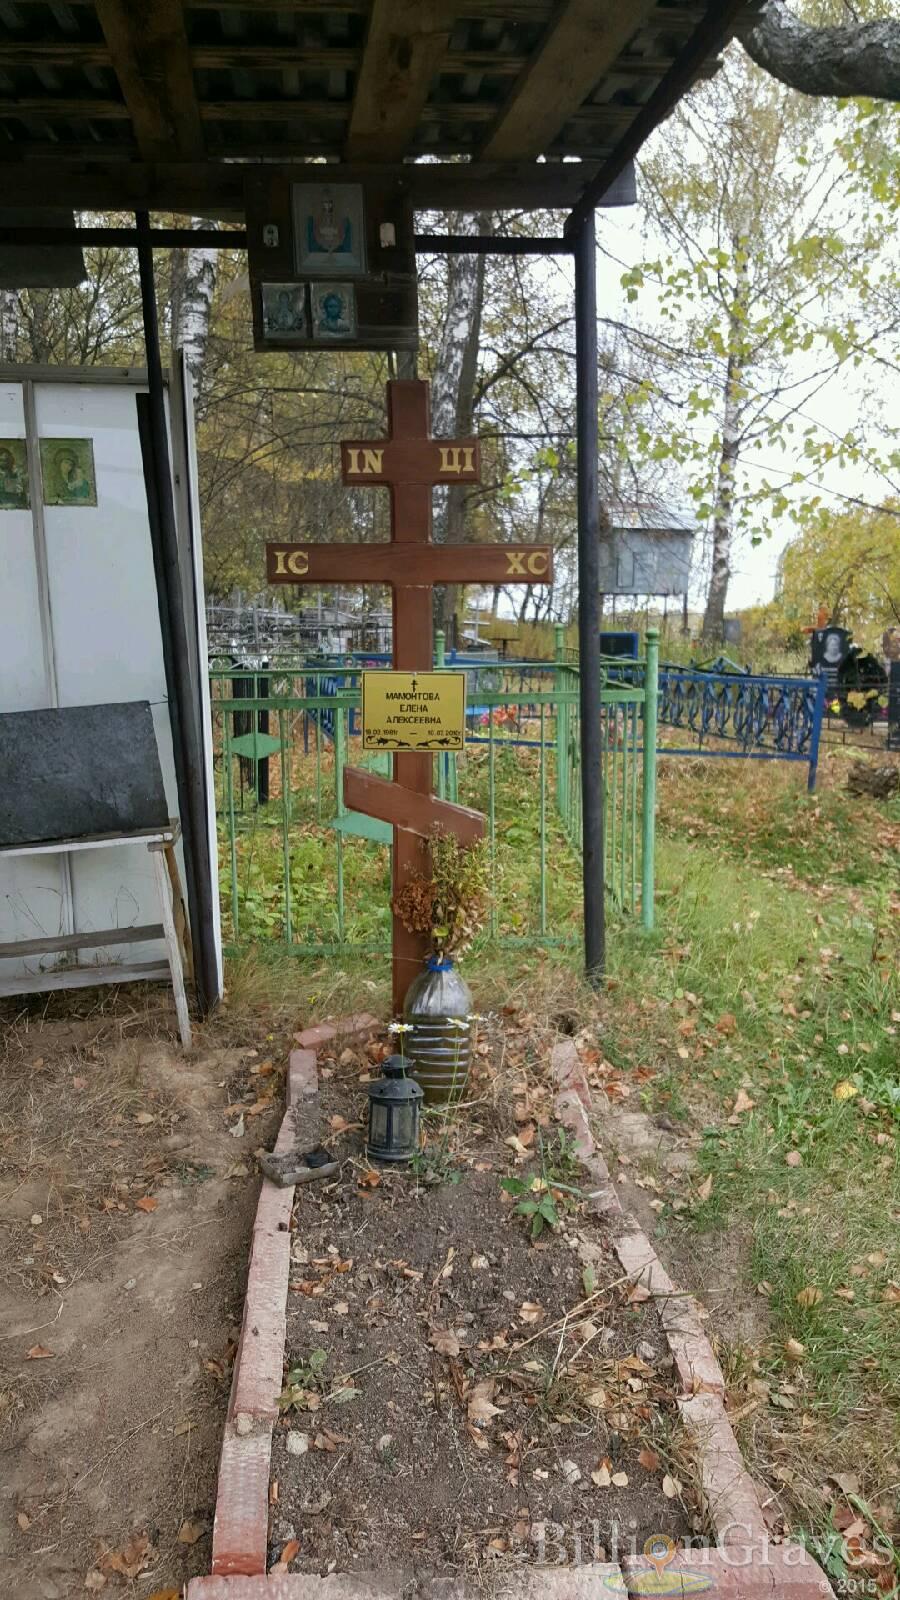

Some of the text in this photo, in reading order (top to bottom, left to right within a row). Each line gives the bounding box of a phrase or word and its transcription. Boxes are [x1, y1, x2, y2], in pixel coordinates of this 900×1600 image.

[386, 692, 440, 700] МАМОНТОВА
[400, 704, 429, 712] ЕЛЕНА
[386, 716, 441, 724] АЛЕКСЕЕВНА
